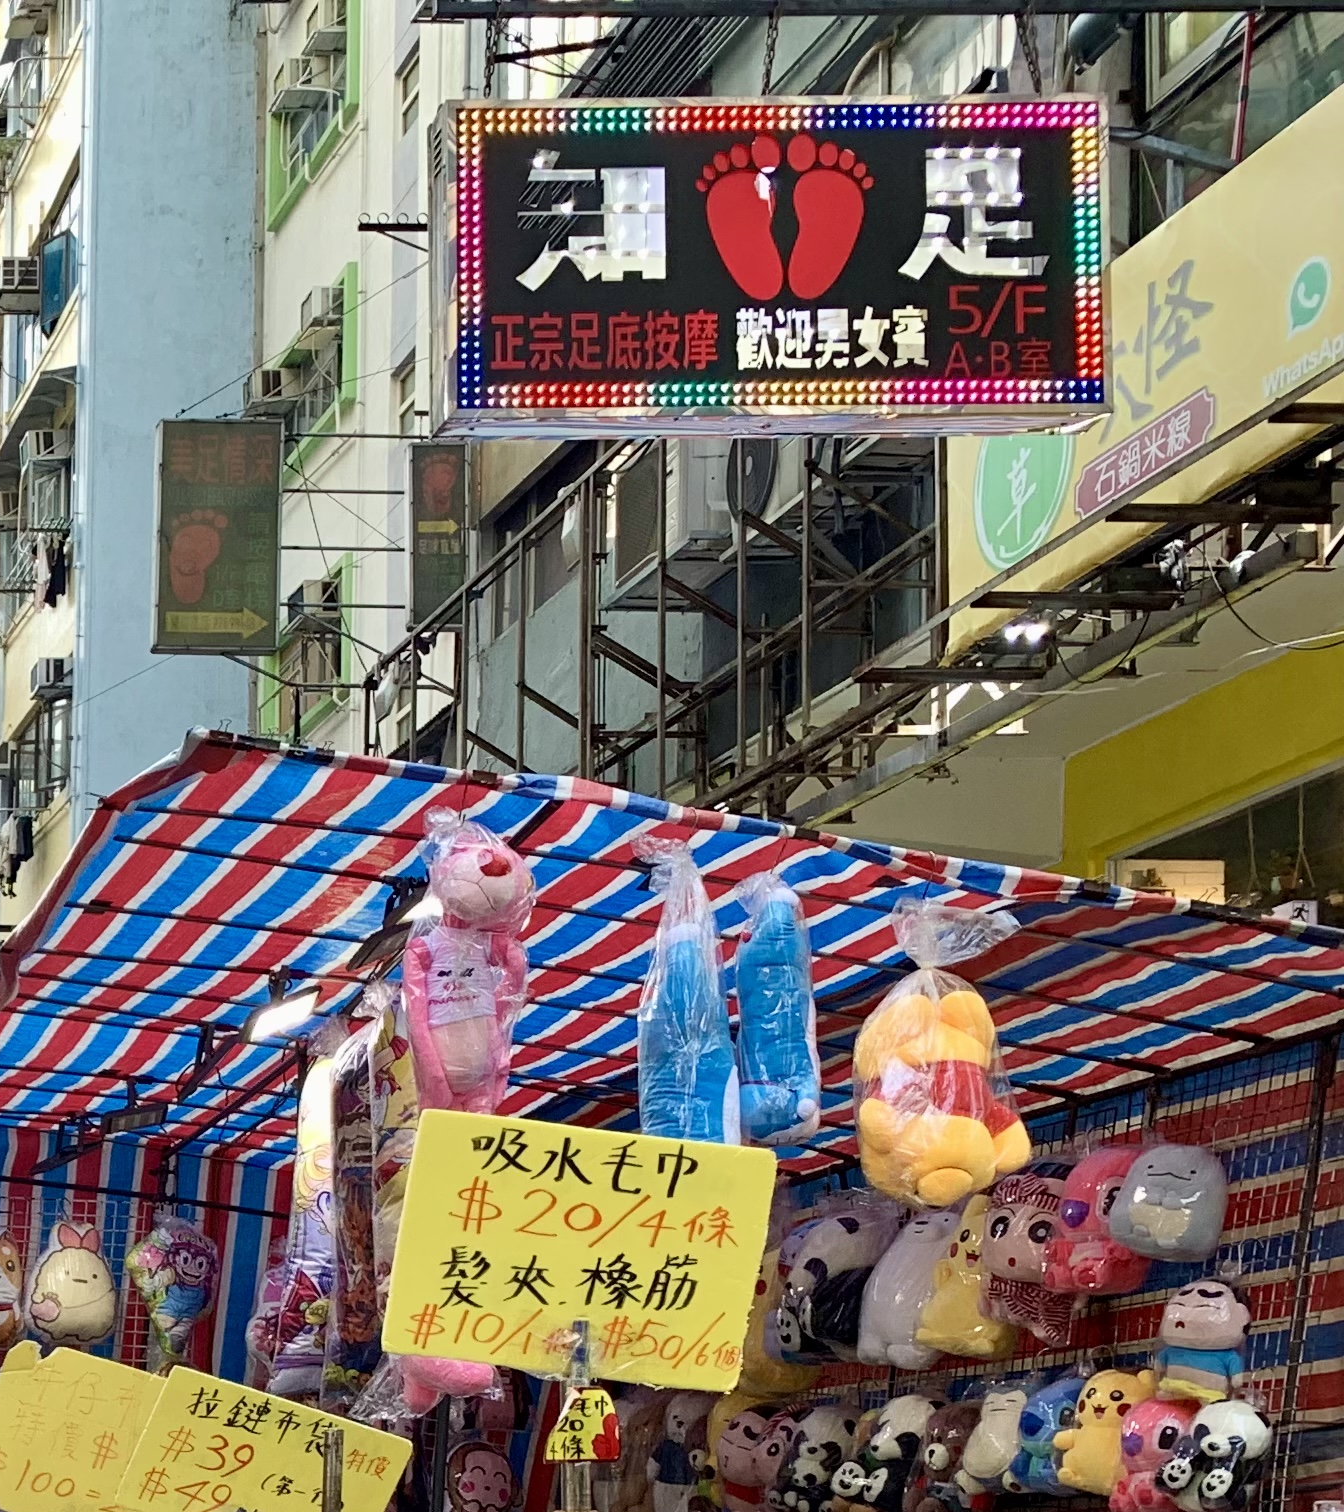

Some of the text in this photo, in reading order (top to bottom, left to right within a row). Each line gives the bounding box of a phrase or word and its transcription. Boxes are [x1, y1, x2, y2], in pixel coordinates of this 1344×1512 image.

[898, 148, 1050, 280] 足
[490, 309, 719, 371] 正宗足底按摩
[736, 305, 930, 371] 歡迎男女賓
[948, 282, 1048, 337] 5/F
[1094, 408, 1192, 502] 石鍋米線
[472, 1128, 699, 1199] 吸水毛巾
[160, 1425, 256, 1478] $39
[557, 1416, 585, 1433] 20
